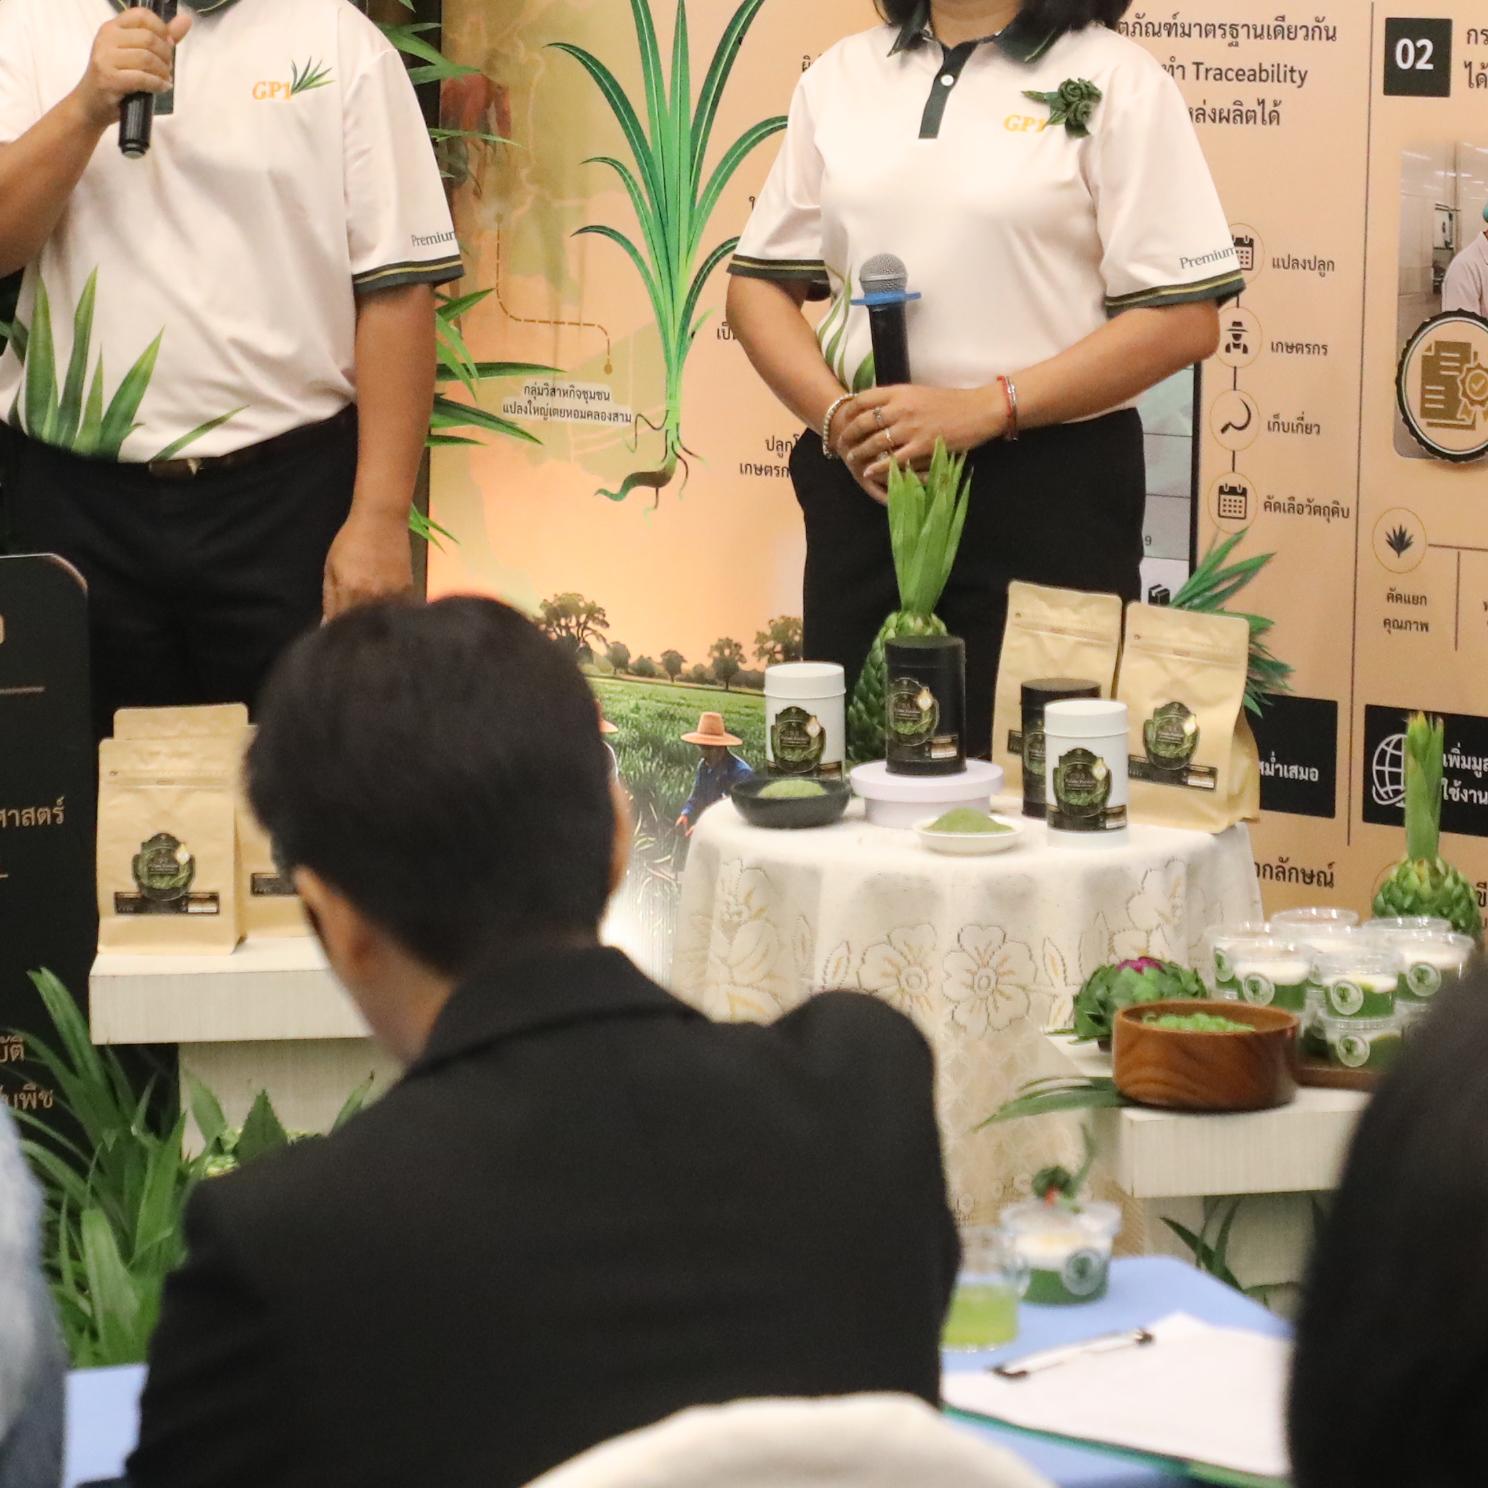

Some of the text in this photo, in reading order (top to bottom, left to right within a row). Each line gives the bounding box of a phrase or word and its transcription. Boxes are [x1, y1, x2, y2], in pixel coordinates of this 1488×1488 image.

[1118, 12, 1338, 48] ตภัณฑ์มาตรฐานเดียวกัน
[1395, 37, 1434, 70] 02
[1191, 61, 1309, 89] Traceability
[253, 81, 293, 100] GP1
[1003, 114, 1046, 133] GP1
[1272, 253, 1335, 278] แปลงปลูก
[1270, 341, 1328, 356] เกษตรกร
[522, 382, 612, 405] กลุ่มวิสาหกิจชุมชน
[502, 400, 633, 424] แปลงใหญ่เตยหอมคลองสาม
[1267, 411, 1321, 436] เก็บเกี่ยว
[1386, 587, 1428, 606] คัดแยก
[1382, 618, 1429, 635] คุณภาพ
